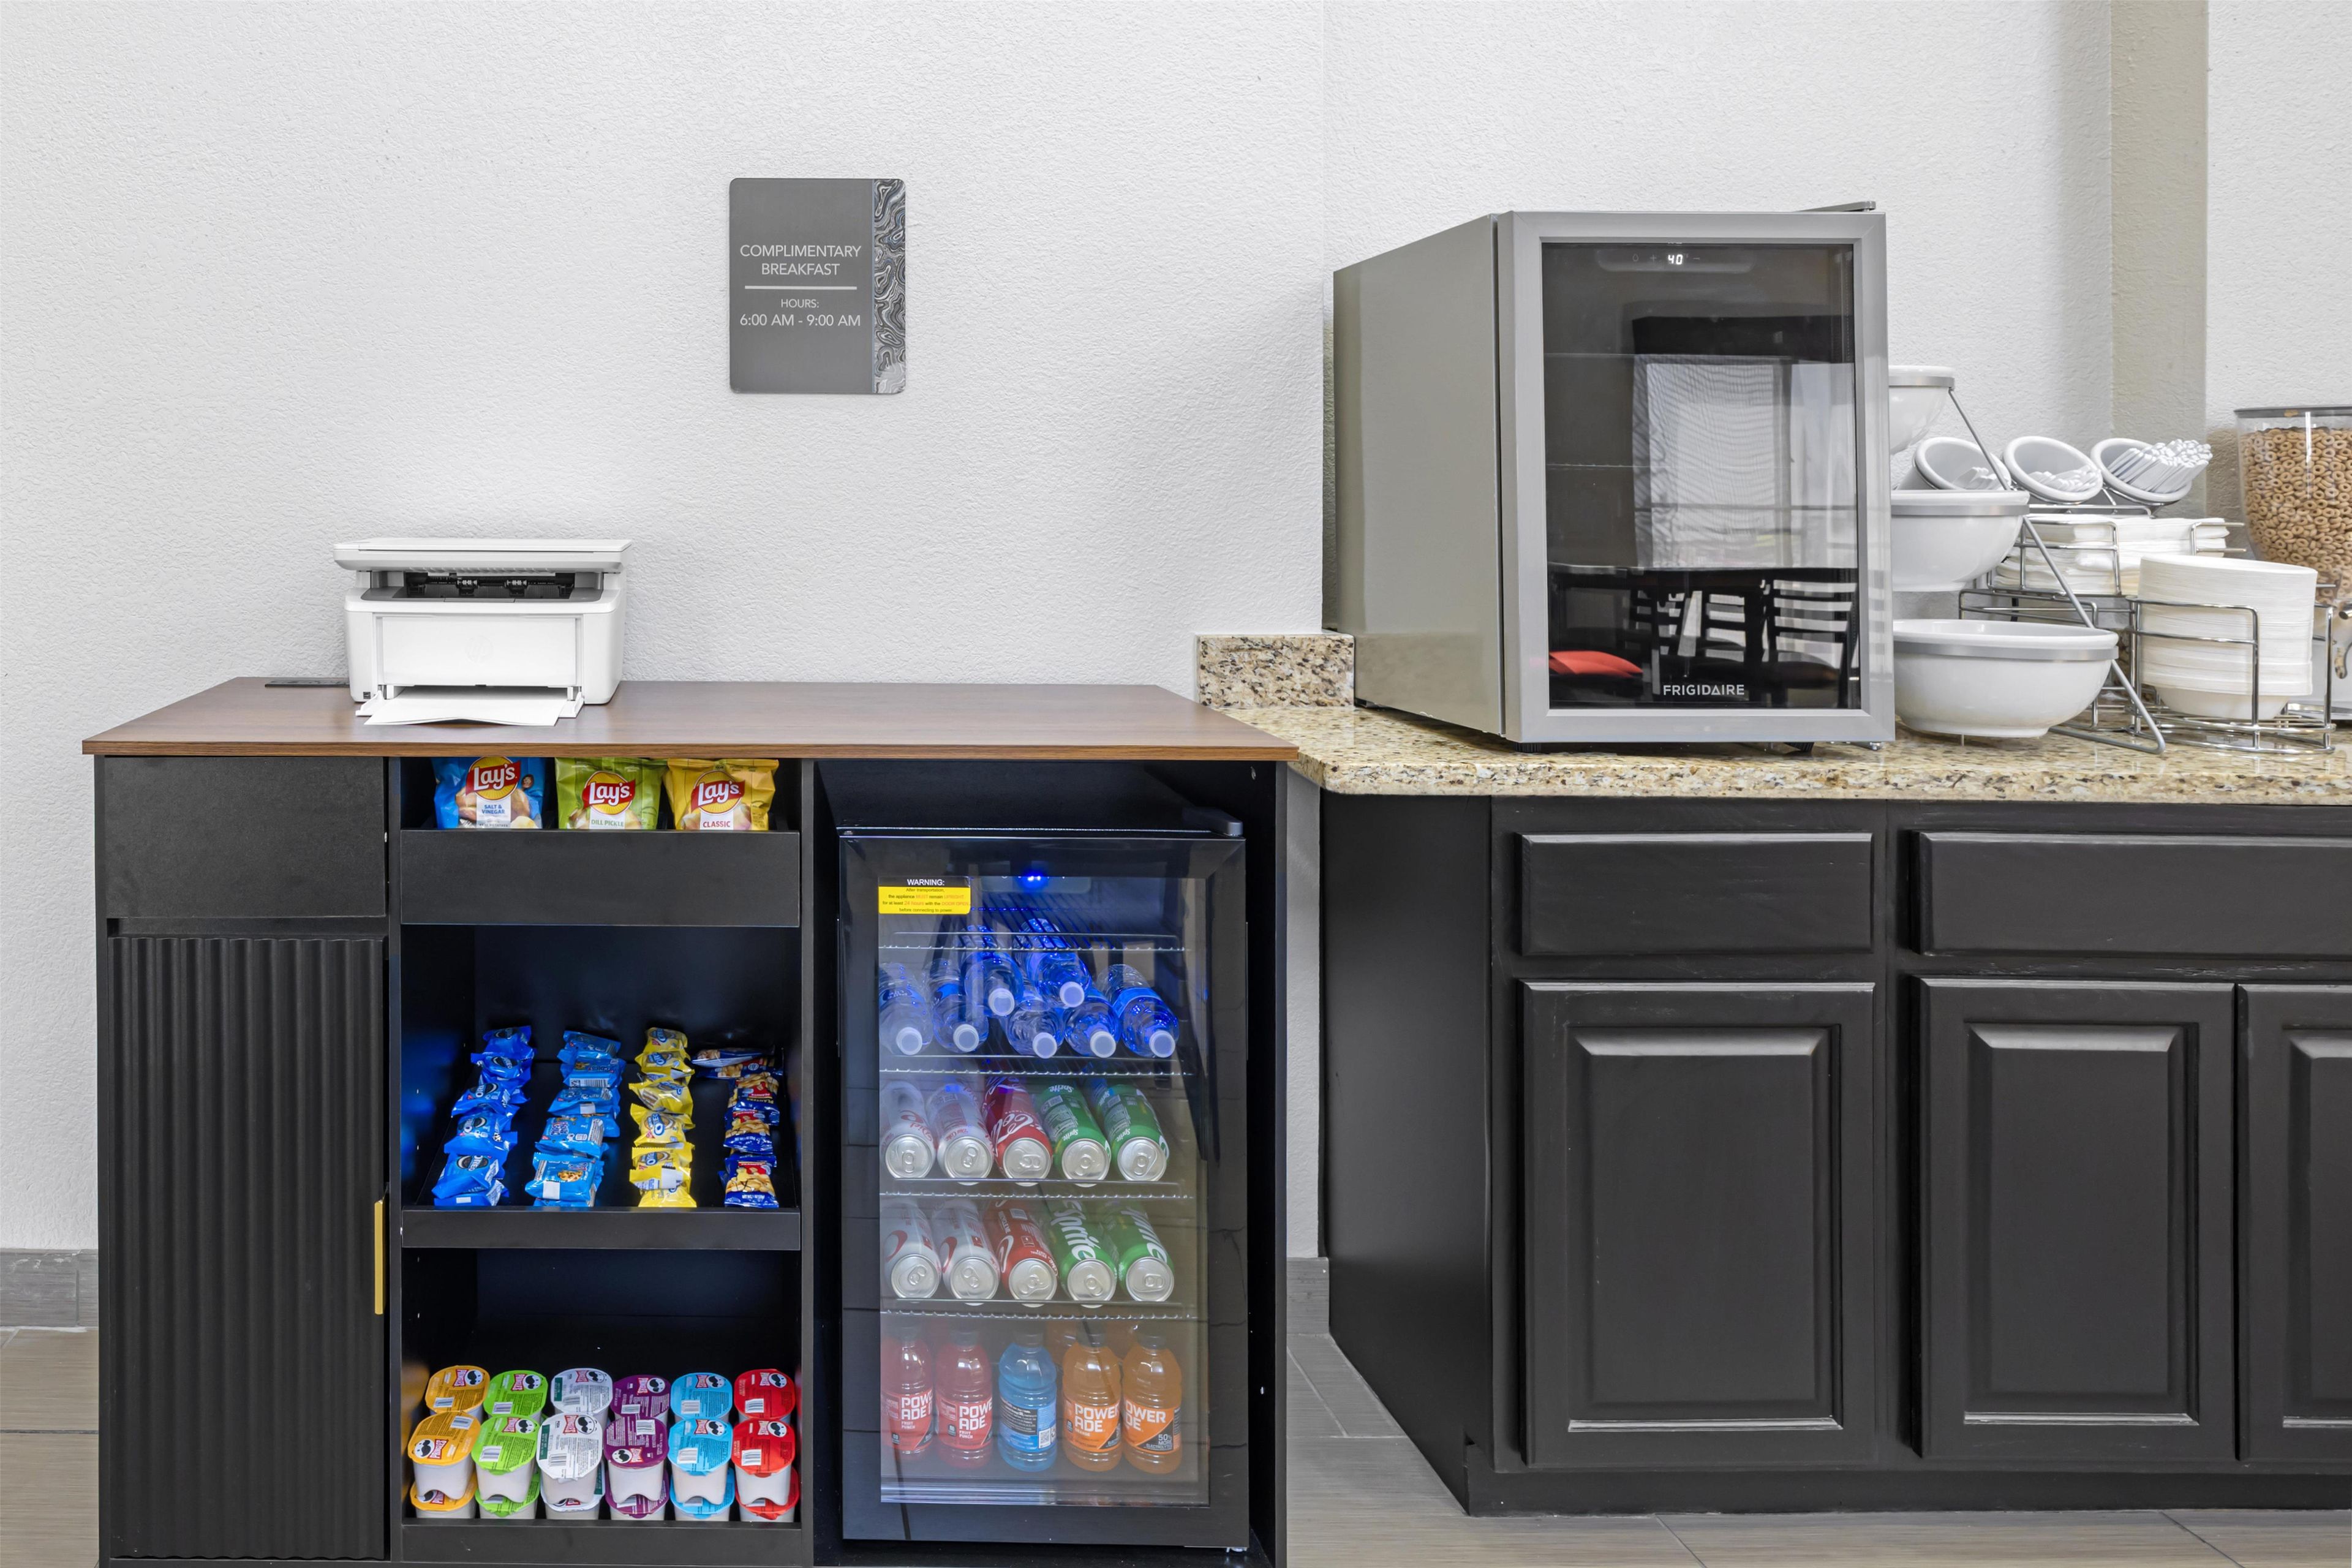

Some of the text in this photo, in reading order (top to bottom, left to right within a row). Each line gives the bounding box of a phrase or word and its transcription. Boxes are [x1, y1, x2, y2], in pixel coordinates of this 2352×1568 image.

[740, 244, 861, 257] COMPLIMENTARY
[1668, 248, 1684, 265] 40
[761, 263, 840, 276] BREAKFAST
[781, 299, 820, 308] HOURS:
[740, 314, 767, 326] 6:00
[771, 314, 794, 326] AM
[807, 314, 834, 326] 9:00
[837, 314, 861, 326] AM
[1663, 685, 1745, 696] FRIGIDAIRE
[473, 764, 516, 791] Lay's
[589, 782, 630, 807] Lay's
[698, 780, 739, 807] Lay's
[902, 1405, 927, 1420] ADE
[959, 1415, 986, 1430] ADE
[1075, 1415, 1103, 1432] ADE
